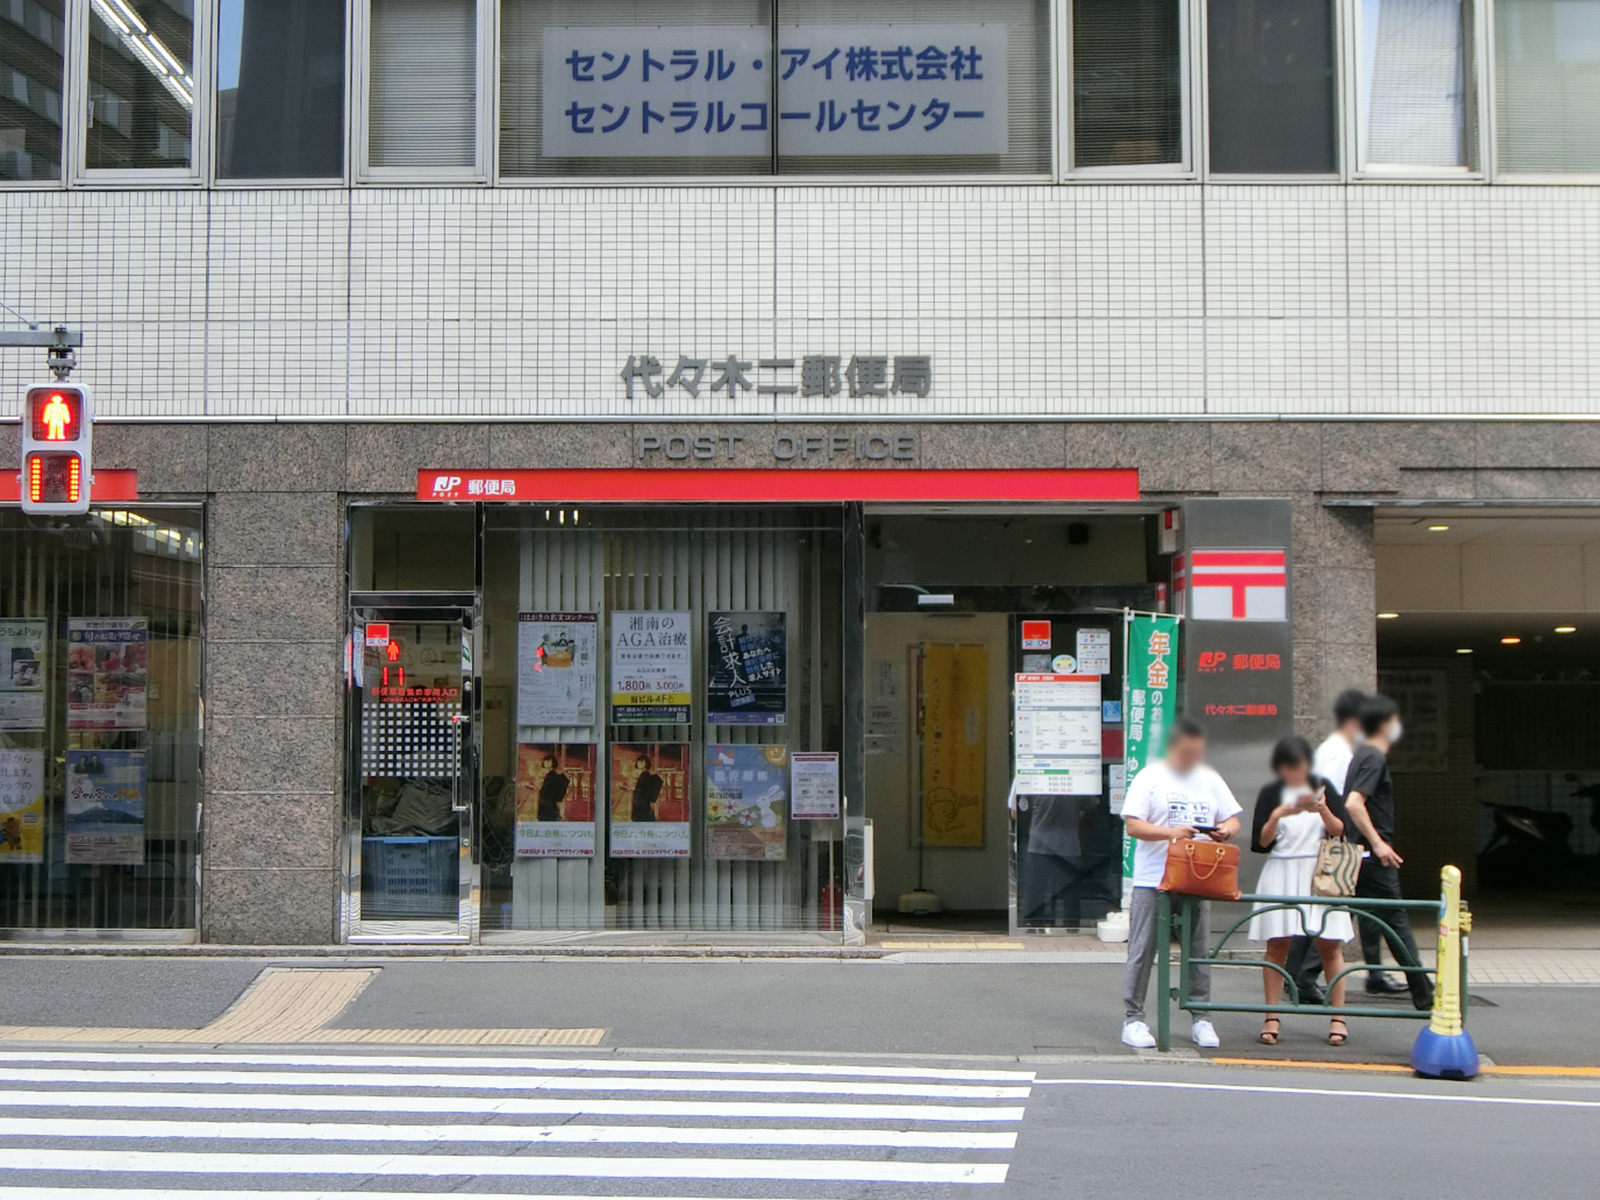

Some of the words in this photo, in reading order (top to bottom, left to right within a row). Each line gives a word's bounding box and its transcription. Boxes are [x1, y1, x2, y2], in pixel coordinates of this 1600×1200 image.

[565, 45, 983, 82] セントラル・アイ株式会社
[565, 98, 984, 133] セントラルコールセンター
[620, 354, 931, 398] 代々木二郵便局
[639, 433, 743, 459] POST
[773, 434, 914, 460] OFFICE
[467, 479, 516, 495] 郵便局
[630, 616, 675, 631] 湘南の
[616, 632, 689, 648] AGA治療
[713, 616, 749, 688] 会計求人
[1232, 653, 1281, 670] 郵便局
[617, 680, 653, 692] 1,800円
[656, 681, 685, 691] 3,000円
[727, 686, 753, 699] PLUS
[1205, 704, 1278, 716] 代々木二郵便局
[518, 829, 595, 840] 今日よ、合格につづけ。
[612, 829, 691, 840] 今日よ、合格につづけ。
